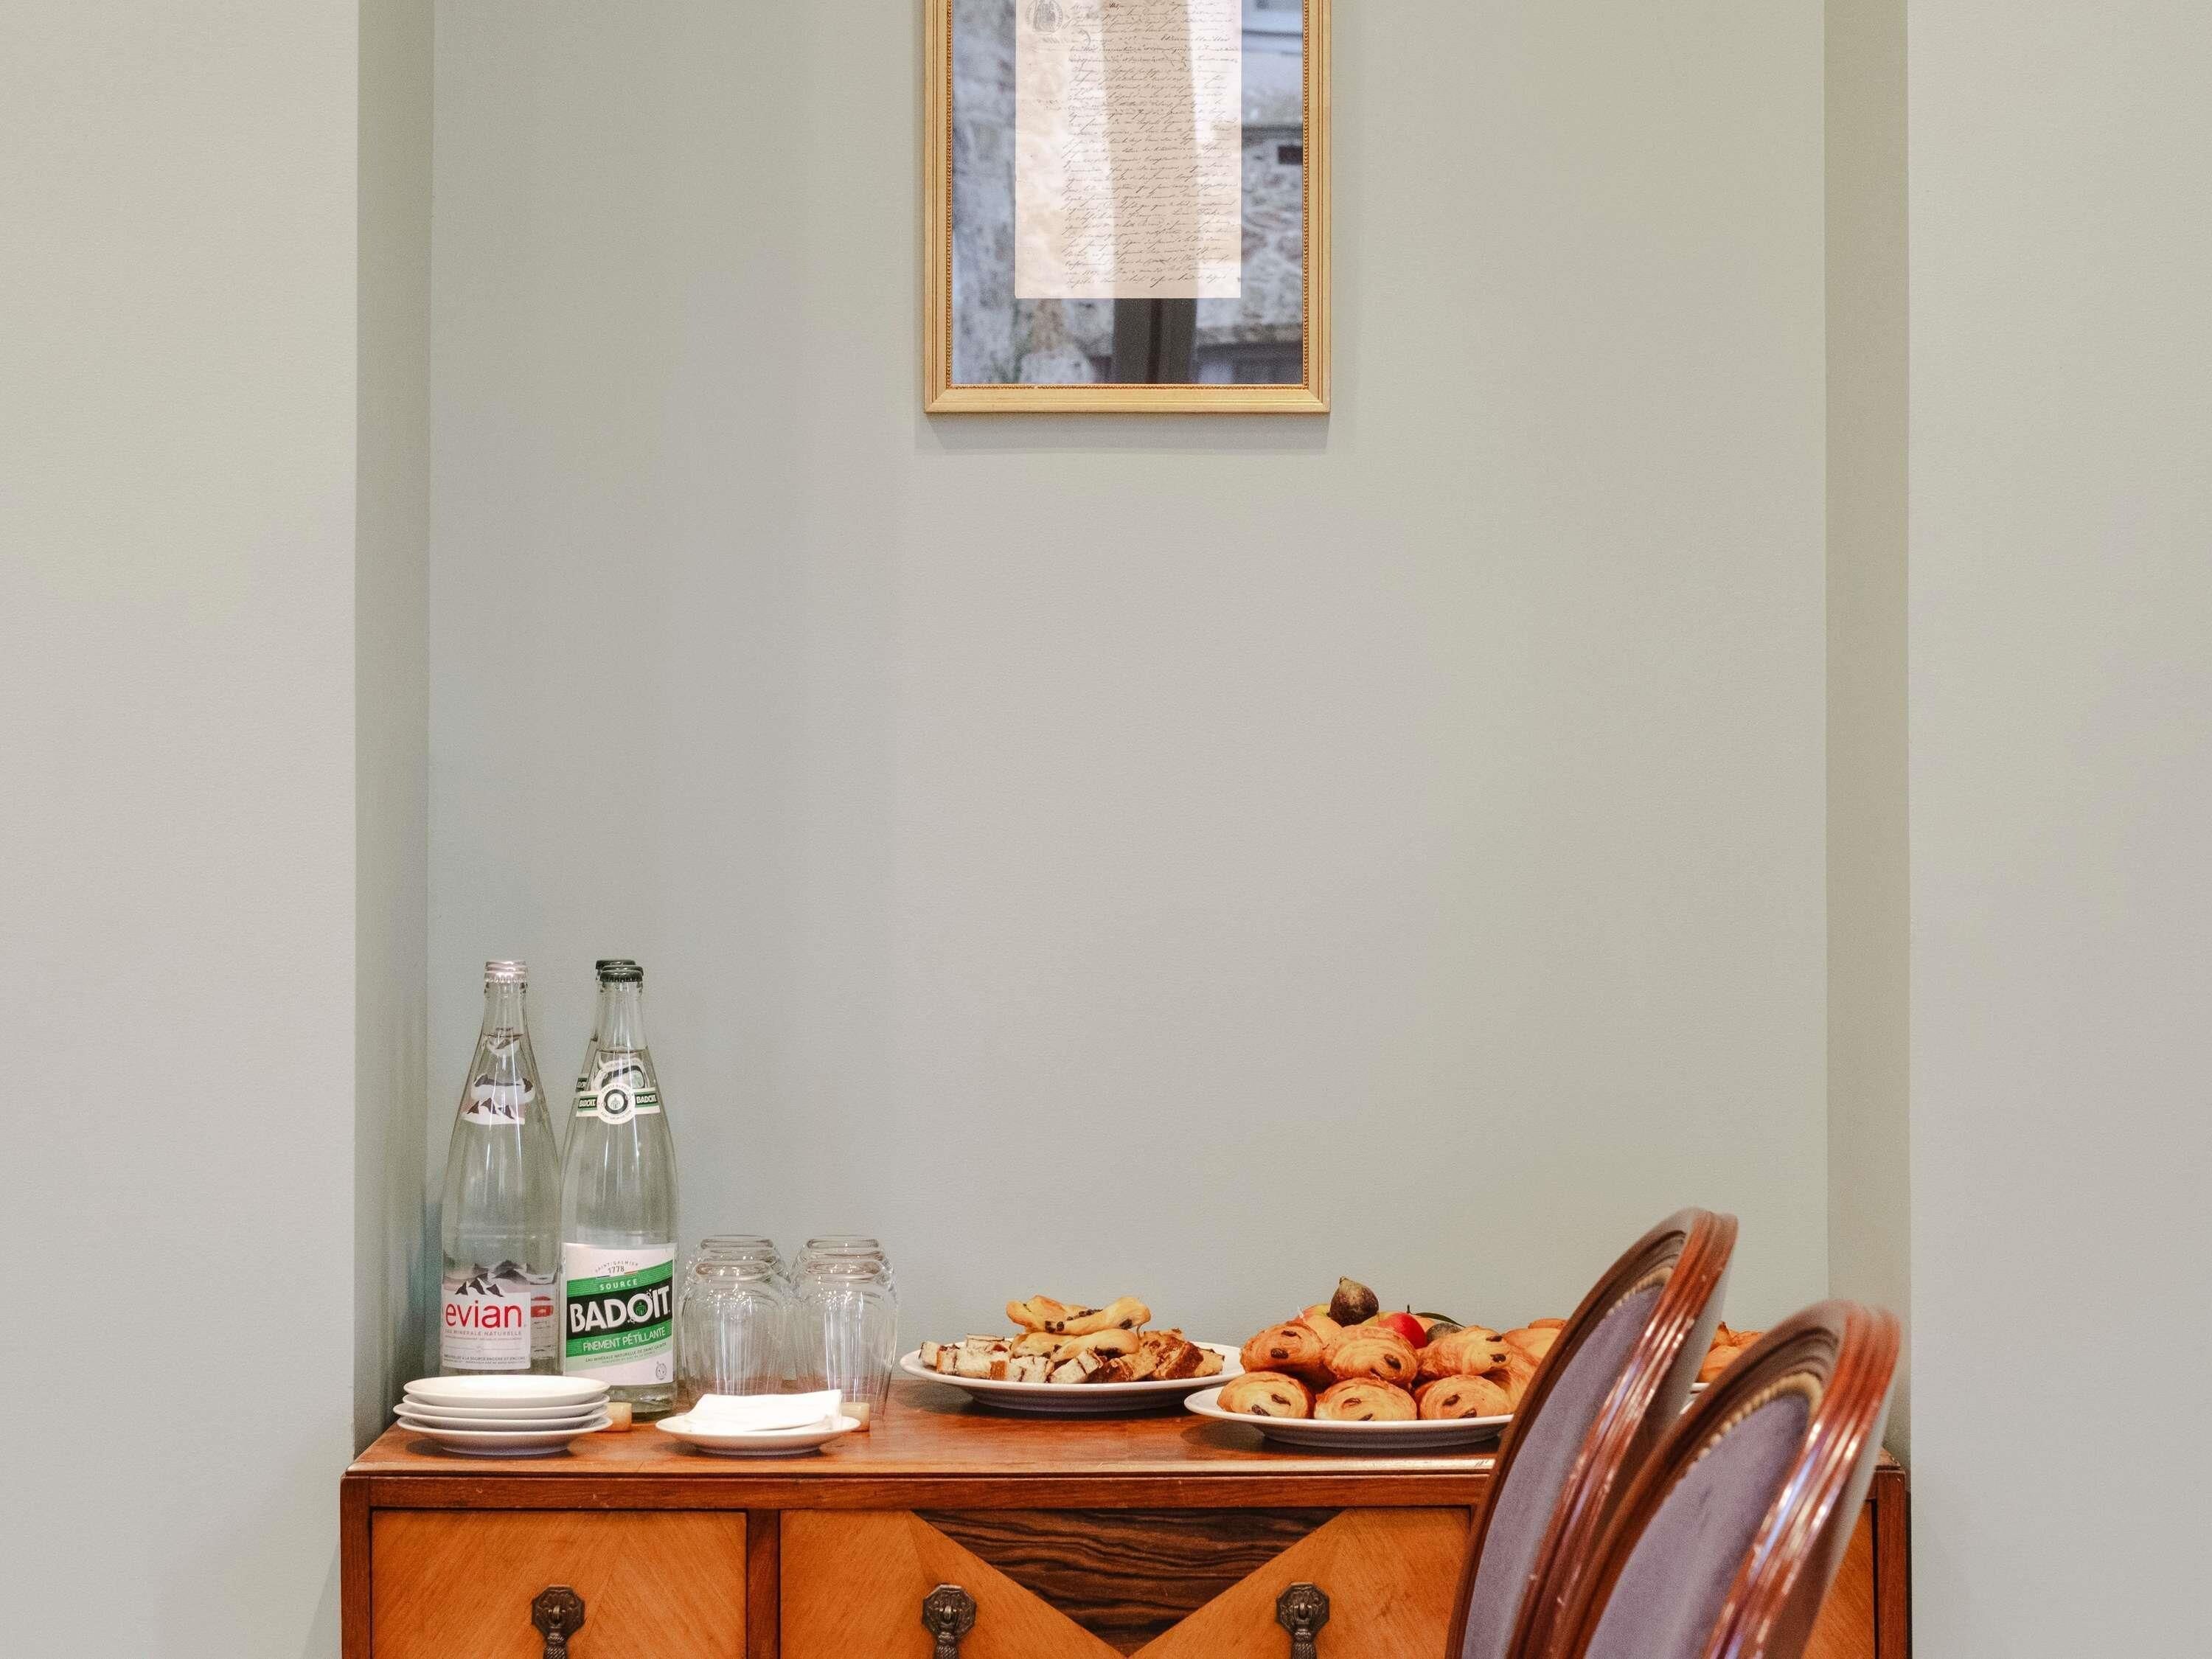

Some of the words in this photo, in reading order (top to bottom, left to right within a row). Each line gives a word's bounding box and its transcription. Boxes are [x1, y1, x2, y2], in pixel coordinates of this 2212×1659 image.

[608, 1265, 625, 1274] 1778
[599, 1279, 638, 1291] SOURCE
[445, 1300, 522, 1329] evian
[569, 1285, 669, 1333] BADOIT
[582, 1337, 621, 1352] FINEMENT
[622, 1326, 667, 1346] PÉTILLANTE
